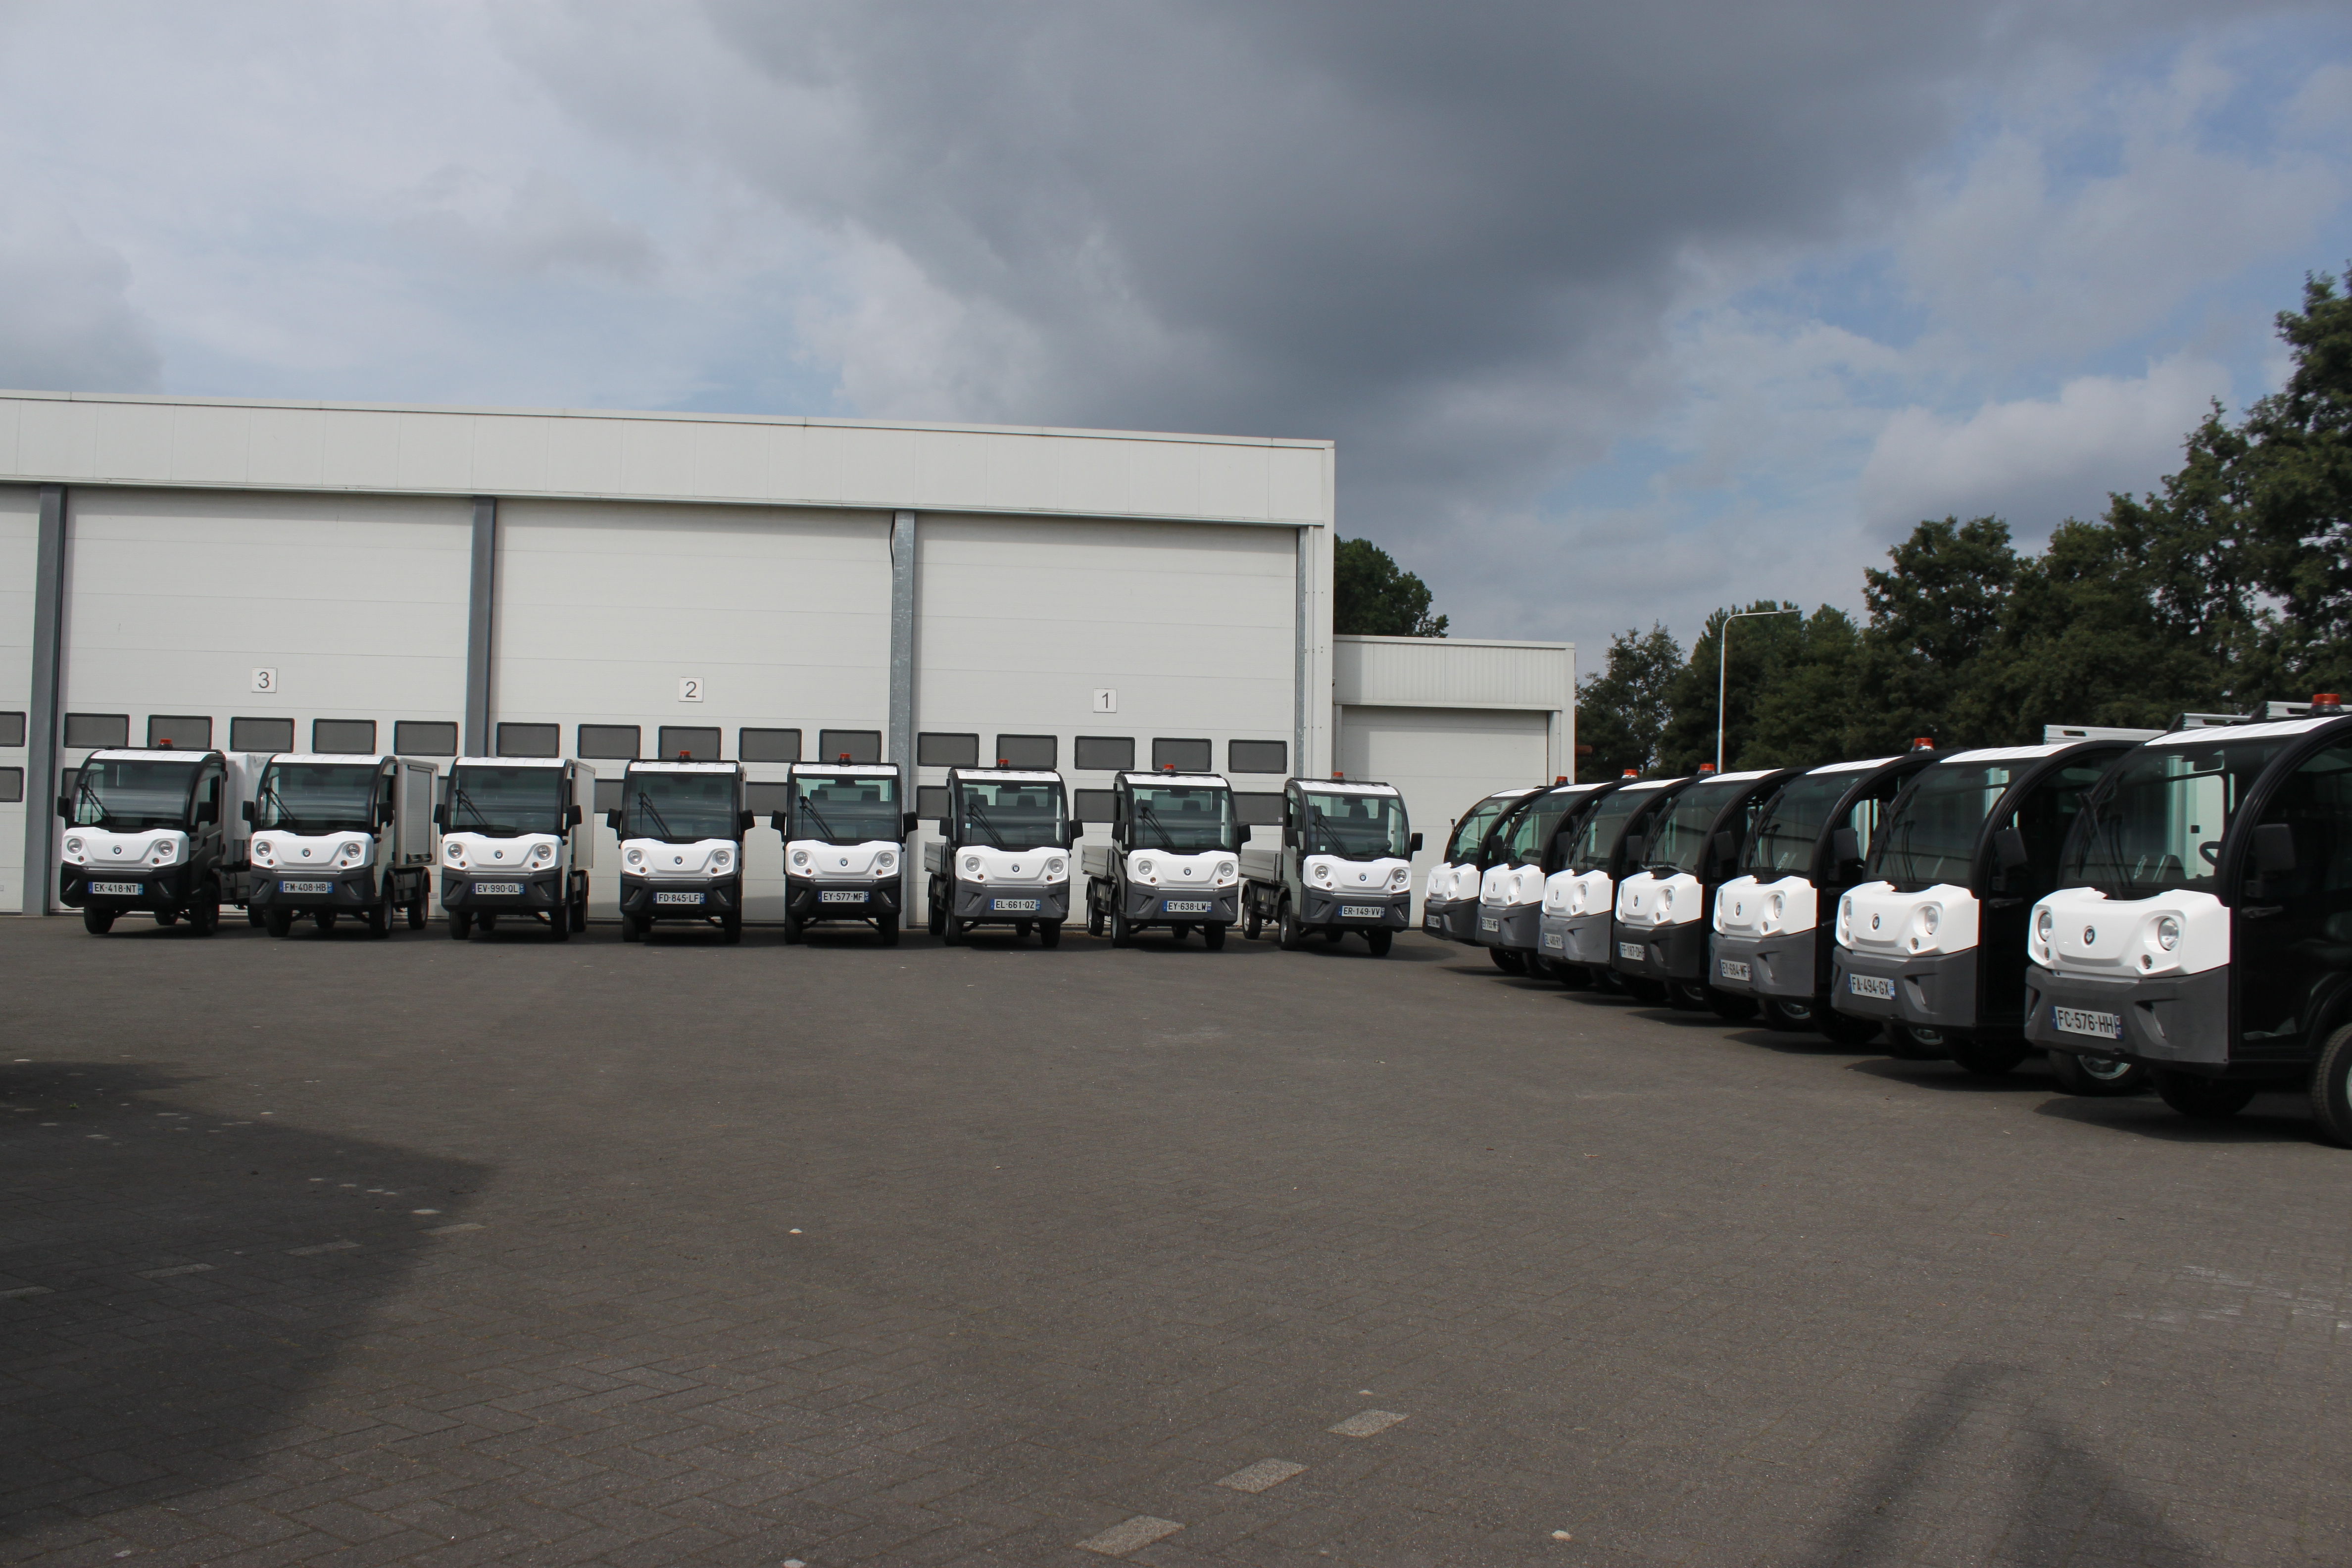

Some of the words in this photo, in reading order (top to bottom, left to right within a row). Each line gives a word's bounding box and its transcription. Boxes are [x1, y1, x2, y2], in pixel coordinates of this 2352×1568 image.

[258, 671, 270, 689] 3
[685, 681, 697, 698] 2
[1102, 692, 1108, 708] 1
[94, 883, 137, 893] EK-418-NT
[285, 883, 327, 891] FM-408-HB
[477, 884, 518, 893] EV-990-QL
[659, 894, 699, 902] FD-845-LF
[1343, 907, 1380, 916] ER-149-VV
[1852, 977, 1890, 996] FA-494-GX
[2058, 1010, 2114, 1034] FC-576-HH
